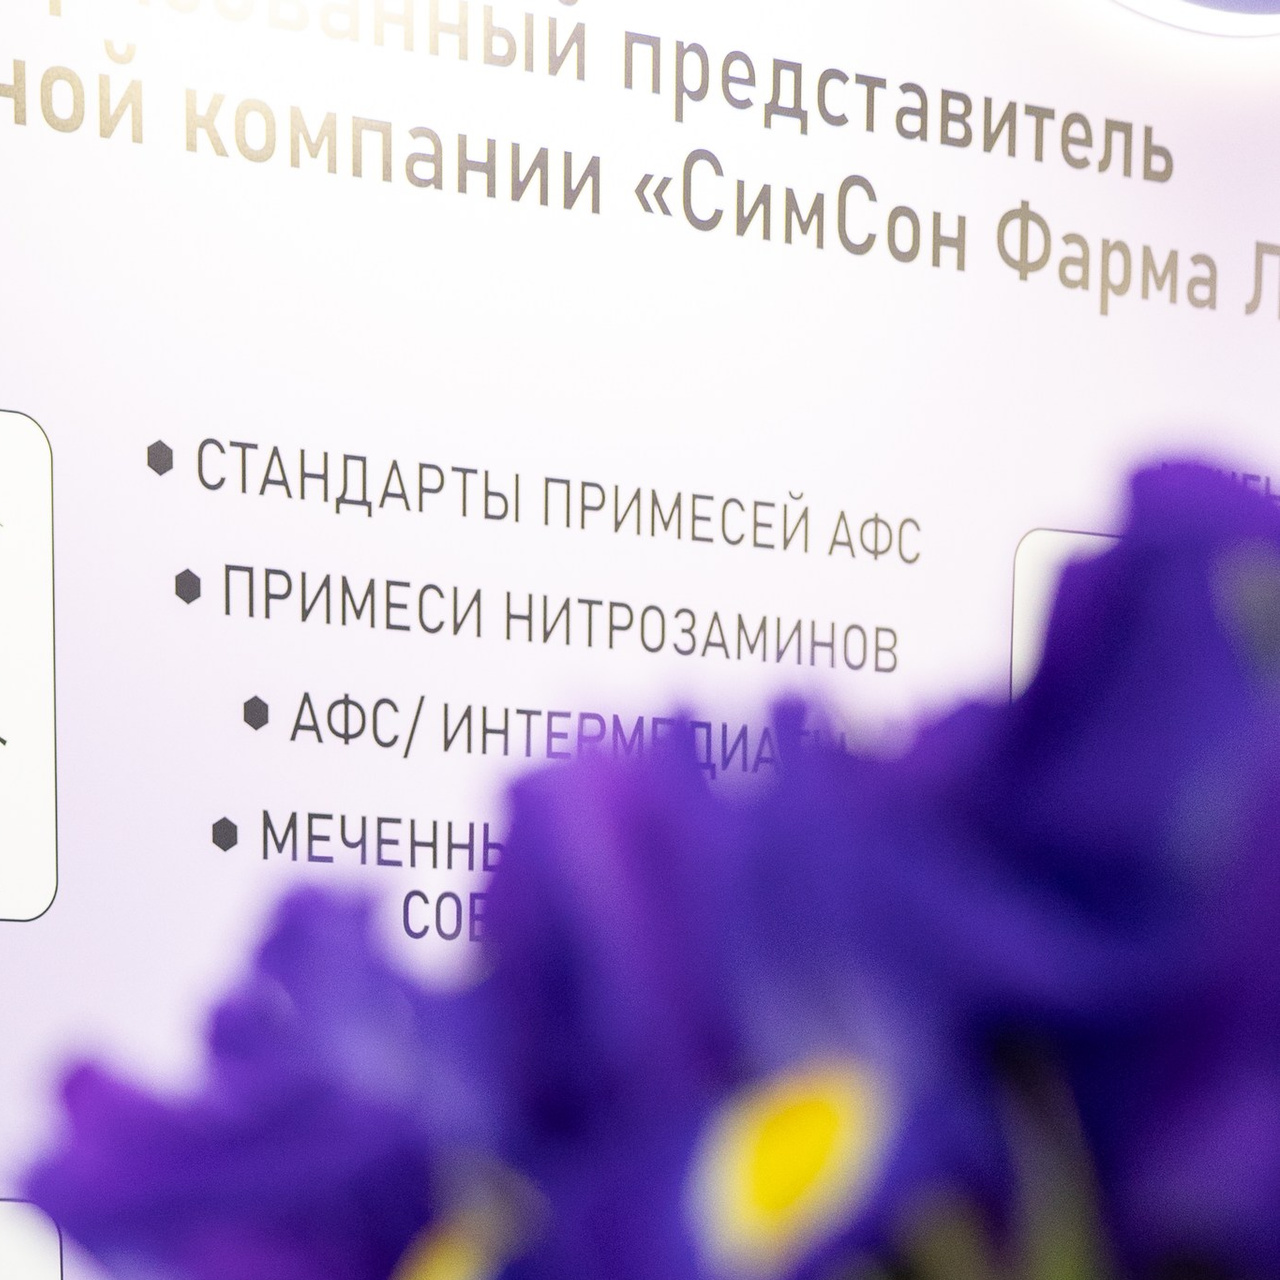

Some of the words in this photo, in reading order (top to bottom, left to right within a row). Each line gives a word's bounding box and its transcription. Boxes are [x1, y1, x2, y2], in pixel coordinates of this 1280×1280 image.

[624, 31, 1174, 183] представитель
[185, 88, 601, 215] компании
[634, 148, 967, 272] «СимСон
[997, 200, 1218, 317] Фарма
[198, 438, 519, 522] СТАНДАРТЫ
[545, 477, 808, 552] ПРИМЕСЕЙ
[828, 511, 920, 564] АФС
[225, 565, 481, 637] ПРИМЕСИ
[506, 592, 897, 673] НИТРОЗАМИНОВ
[290, 692, 424, 758] АФС/
